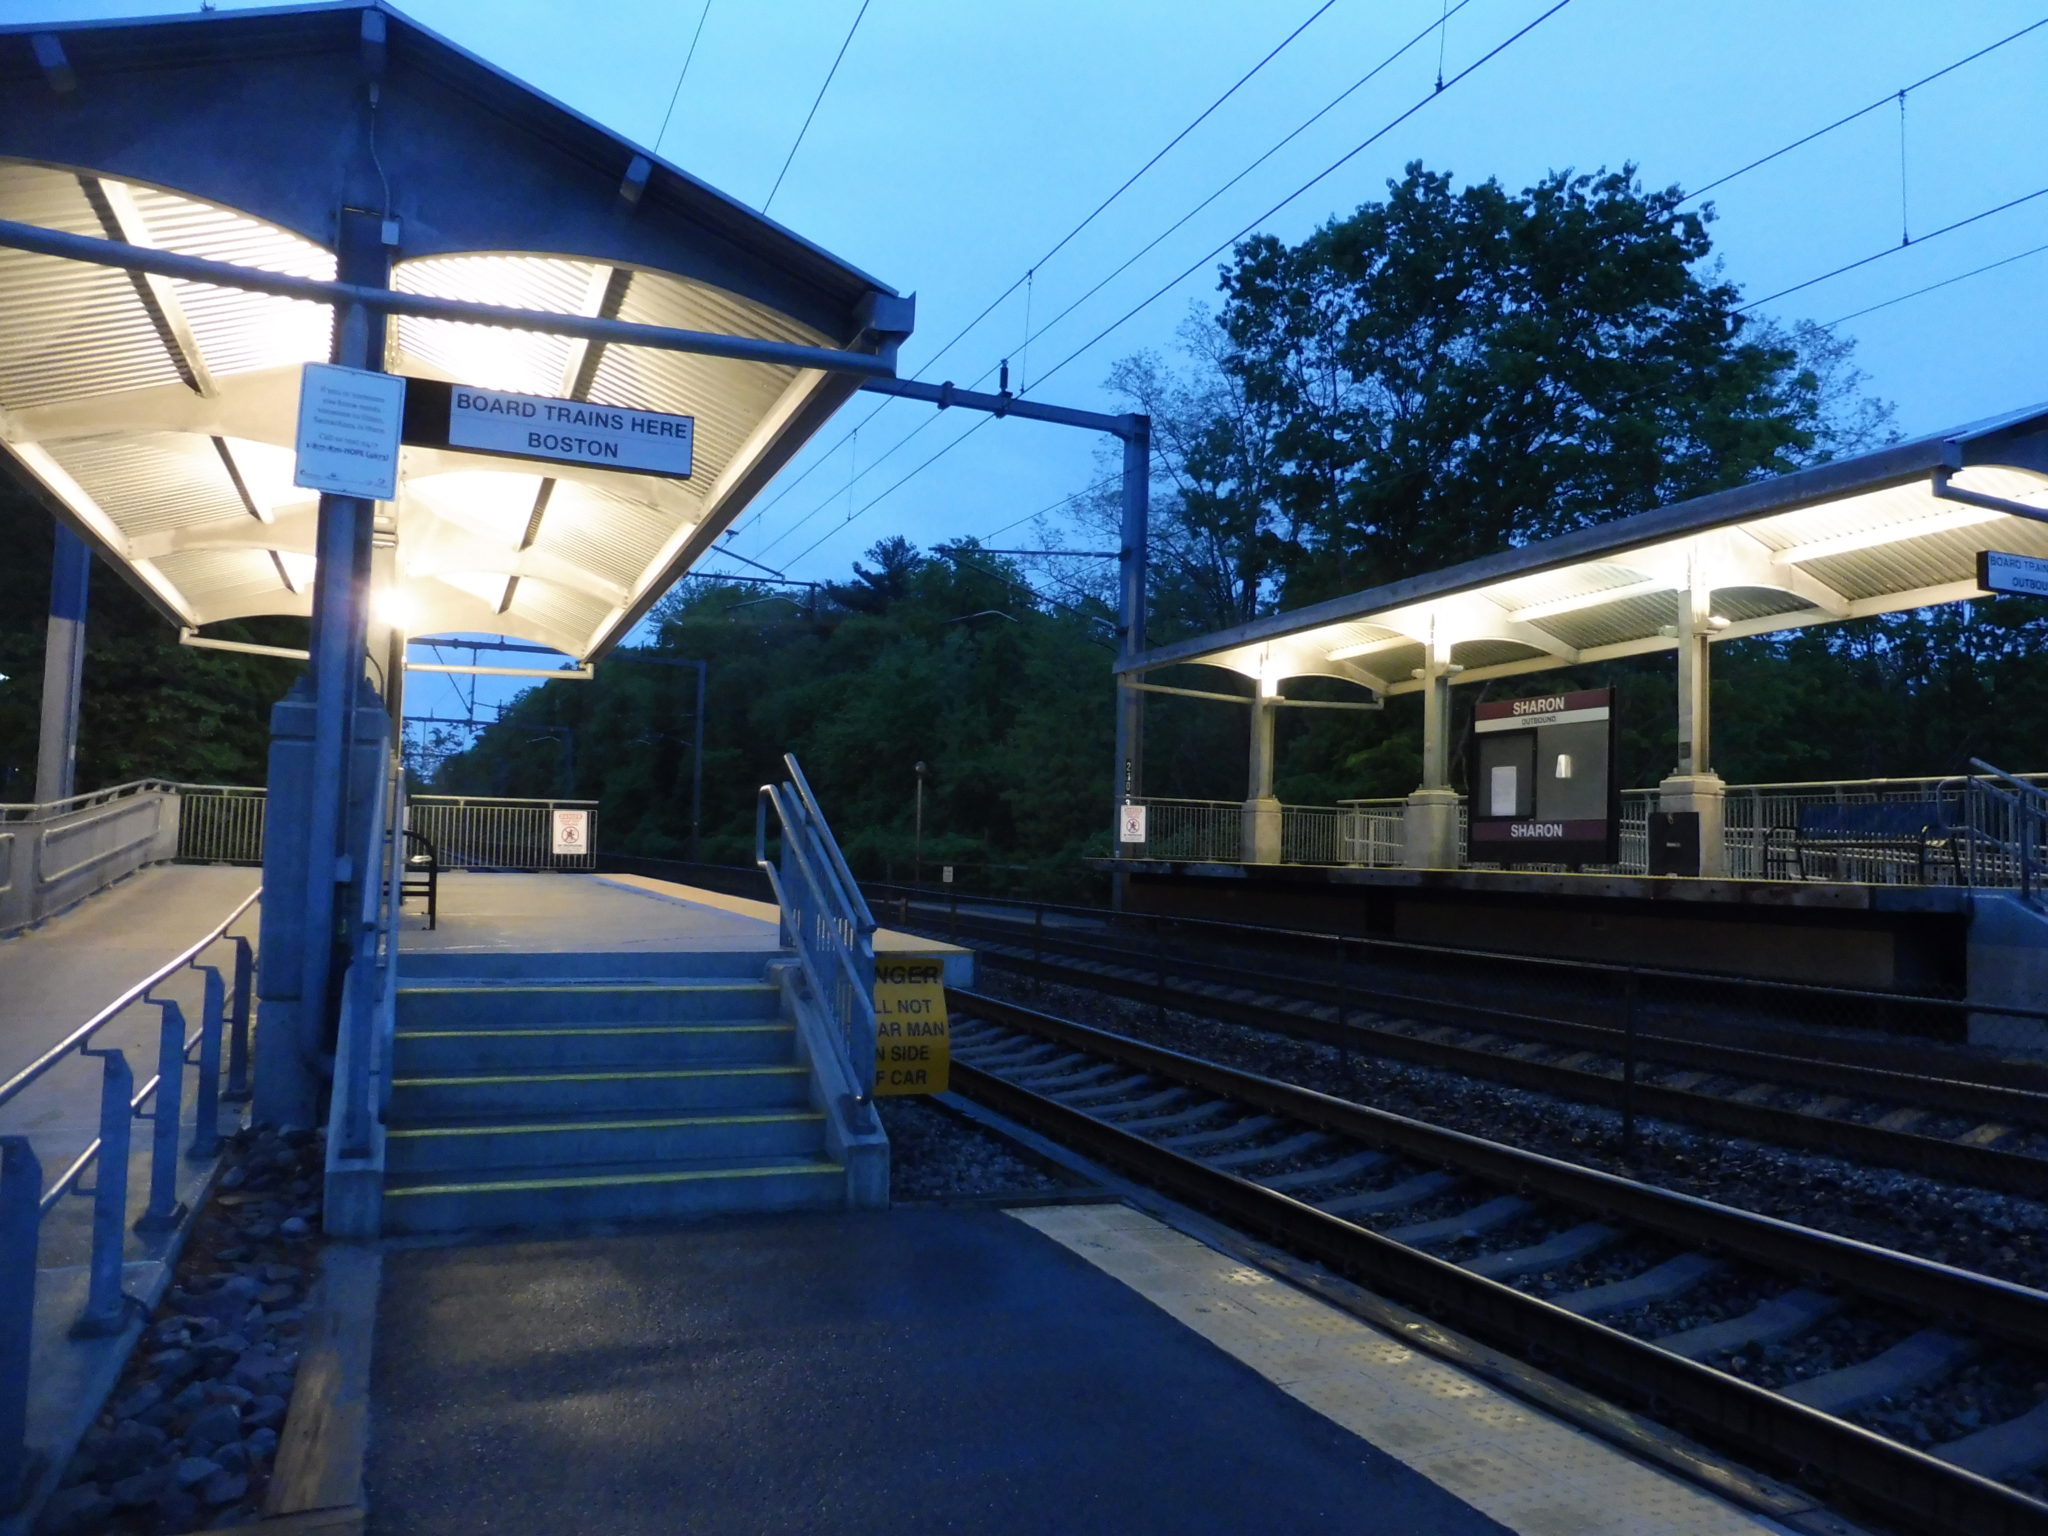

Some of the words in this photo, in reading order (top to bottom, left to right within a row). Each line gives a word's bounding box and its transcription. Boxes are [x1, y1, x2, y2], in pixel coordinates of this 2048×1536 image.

[456, 393, 537, 418] BOARD
[544, 405, 624, 431] TRAINS
[631, 417, 688, 440] HERE
[528, 432, 619, 459] BOSTON
[1991, 555, 2021, 569] BOARD
[1513, 696, 1565, 715] SHARON
[1521, 715, 1556, 726] OUTBOUND
[1511, 823, 1563, 838] SHARON
[874, 966, 938, 984] NGER
[874, 999, 893, 1014] LL
[898, 999, 932, 1014] NOT
[877, 1022, 902, 1037] AR
[907, 1021, 945, 1037] MAN
[875, 1046, 885, 1061] N
[891, 1045, 930, 1062] SIDE
[875, 1071, 886, 1086] F
[891, 1069, 928, 1086] CAR
